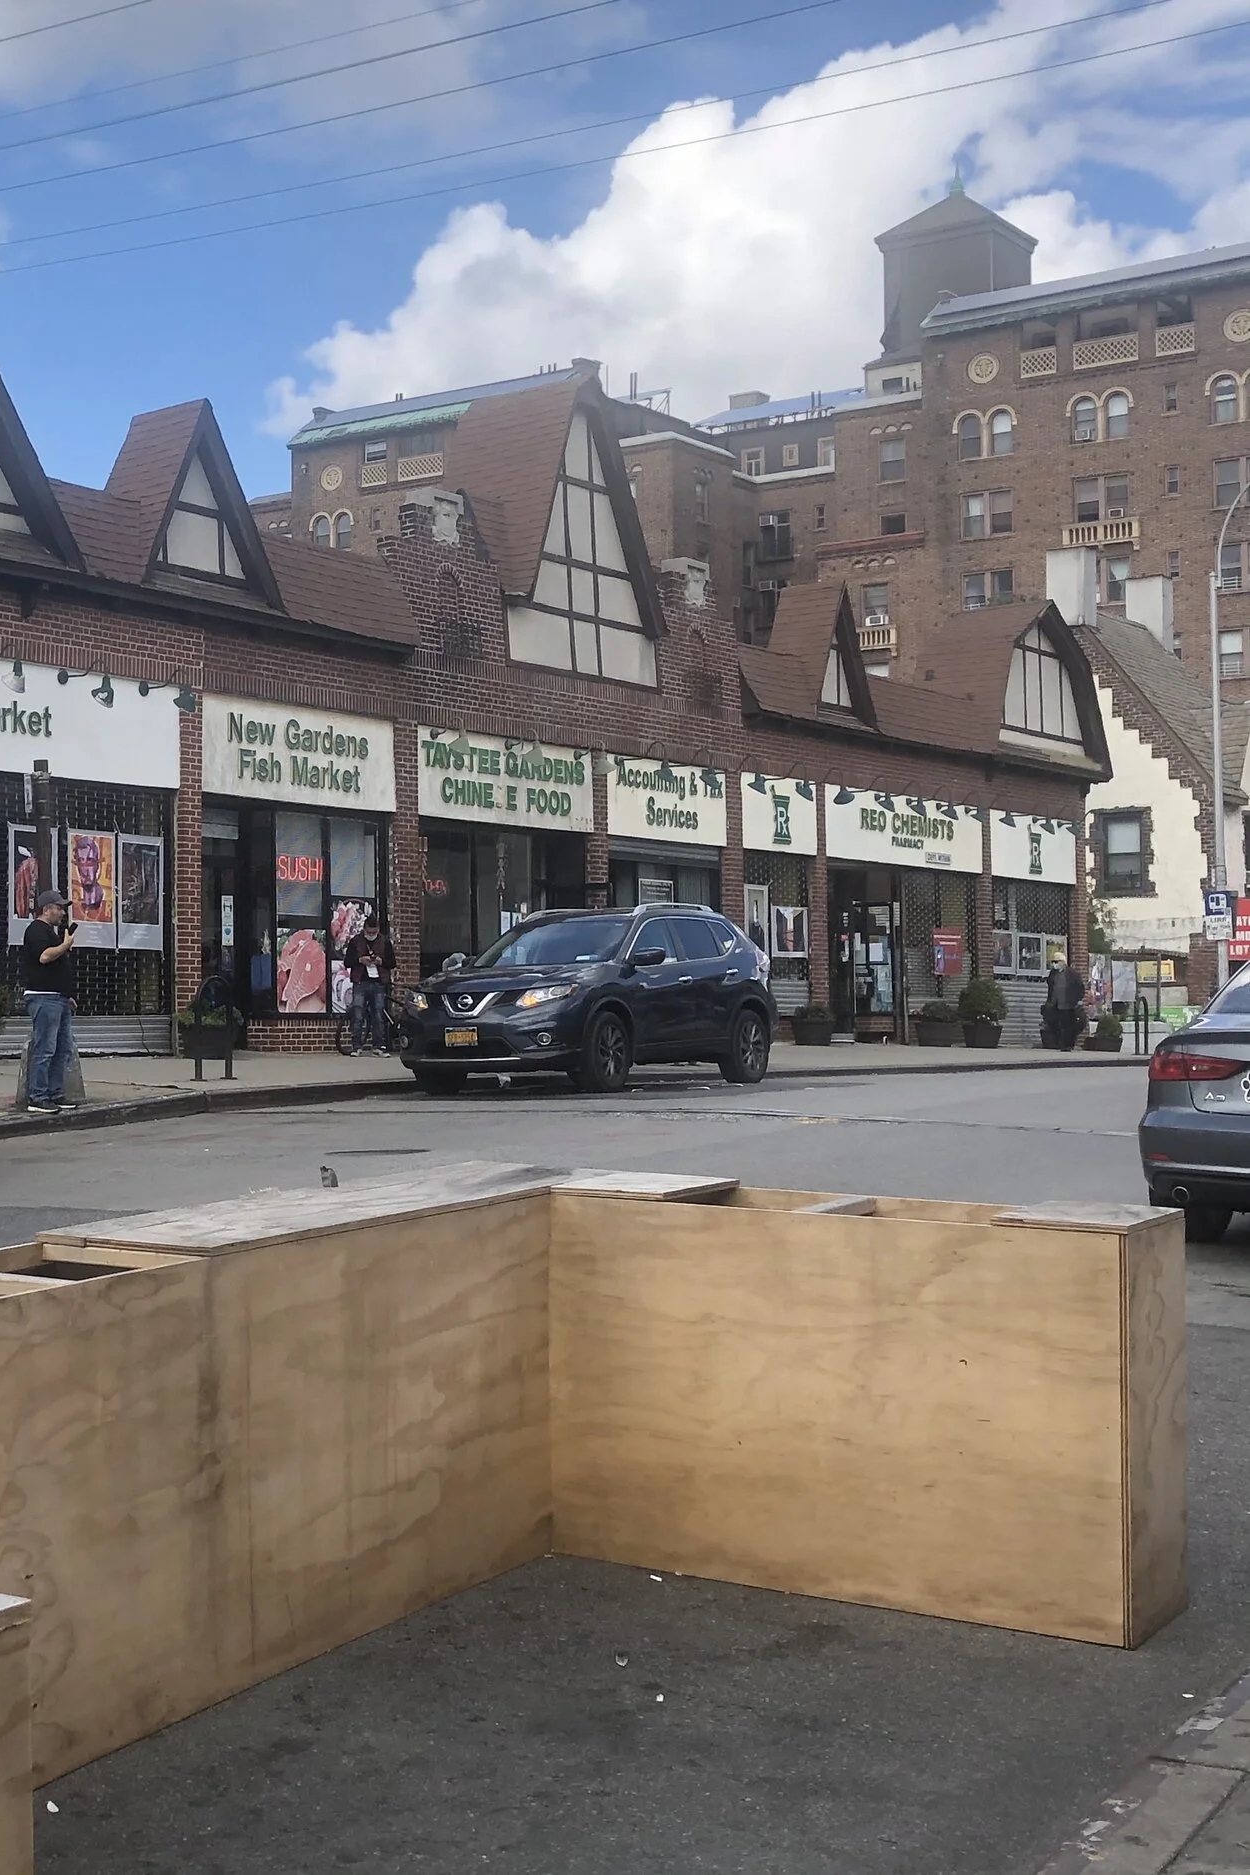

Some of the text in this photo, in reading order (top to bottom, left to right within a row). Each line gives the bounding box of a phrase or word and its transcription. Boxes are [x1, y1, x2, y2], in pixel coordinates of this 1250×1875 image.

[227, 711, 369, 760] New Gardens
[237, 747, 361, 794] Fish Market
[689, 771, 698, 796] &
[525, 787, 572, 817] FOOD
[646, 796, 699, 830] Services
[891, 812, 954, 842] CHEMISTS
[277, 855, 323, 882] SUSHI
